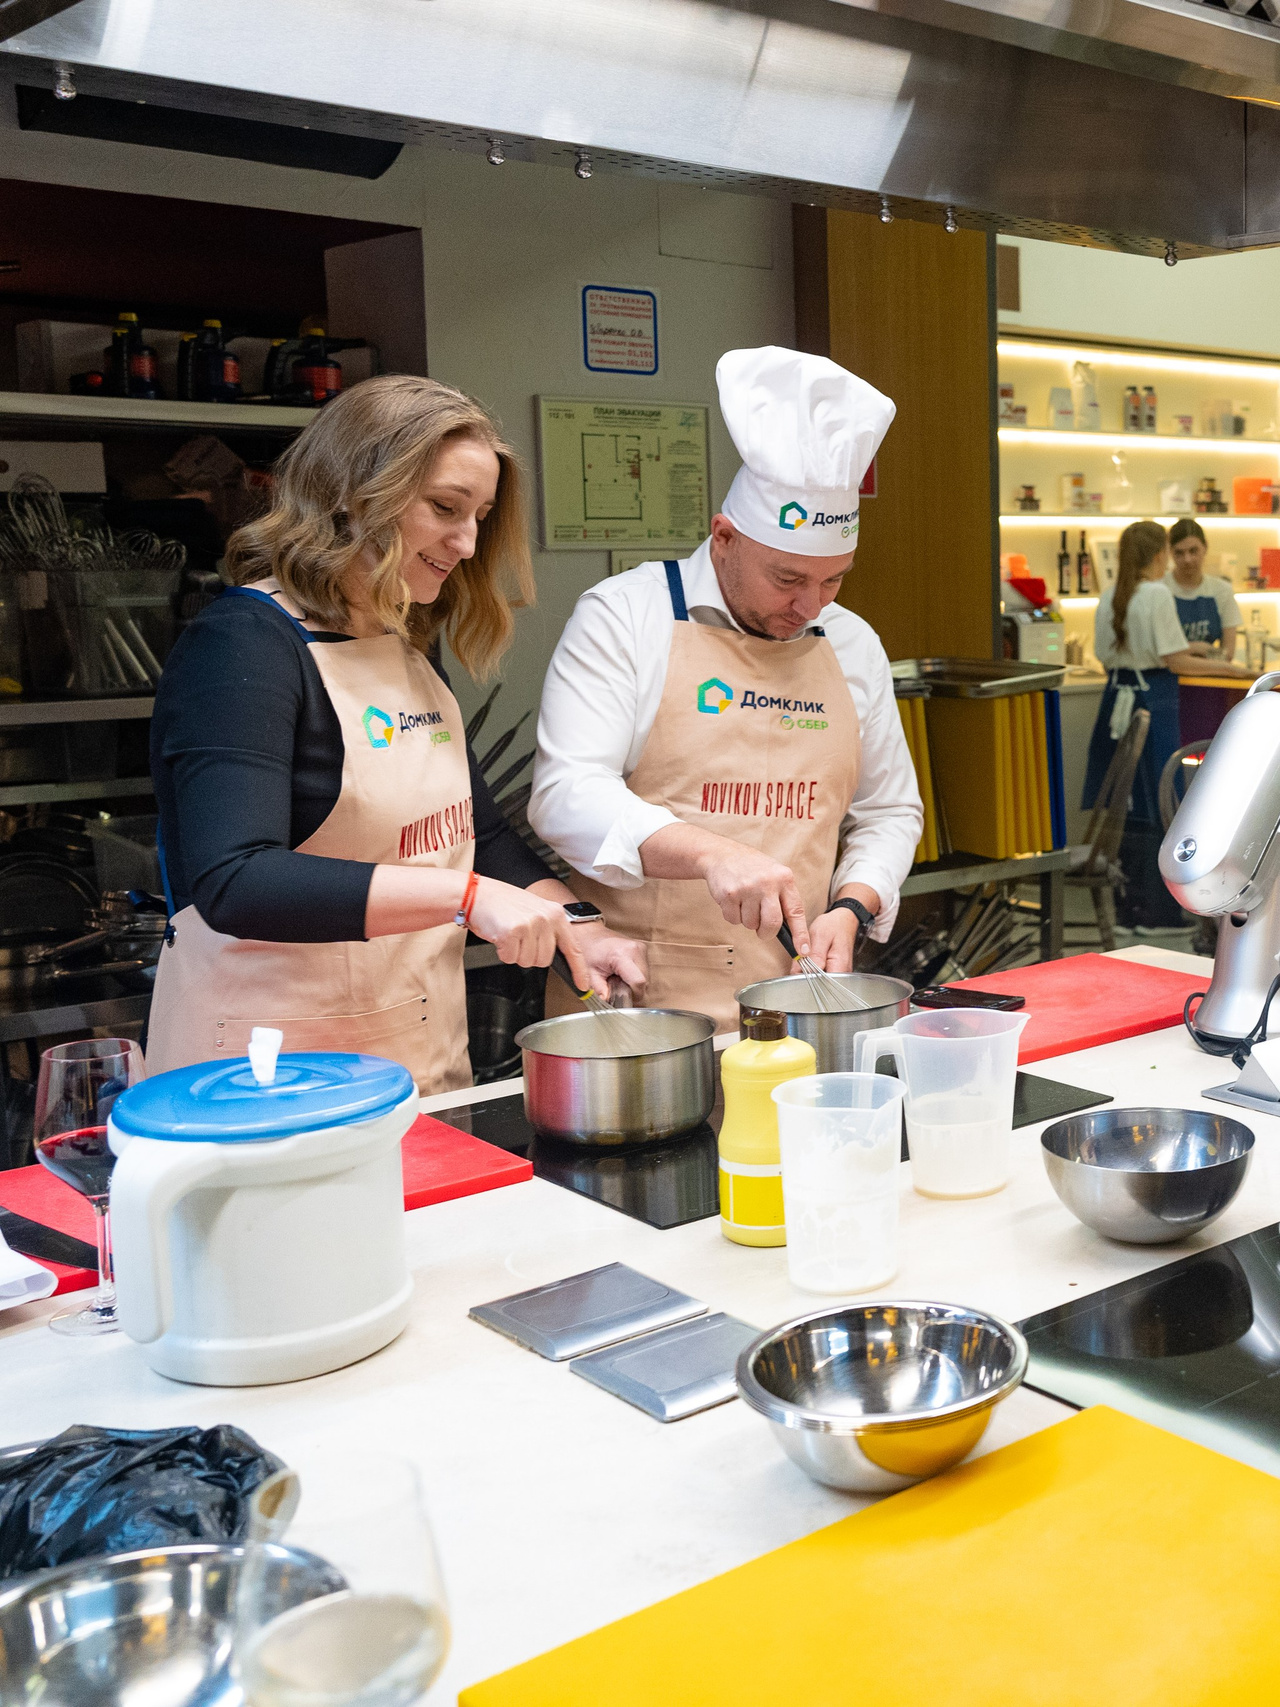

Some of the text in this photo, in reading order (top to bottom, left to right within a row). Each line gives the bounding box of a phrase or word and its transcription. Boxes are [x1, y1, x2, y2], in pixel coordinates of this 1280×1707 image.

[589, 294, 652, 305] ОТВЕТСТВЕННЫЙ
[593, 407, 662, 418] ПЛАН ЭВАКУАЦИИ
[740, 690, 826, 714] Домклик
[398, 711, 444, 734] Домклик
[796, 718, 829, 731] СБЕР
[700, 781, 818, 820] NOVIKOV SPACE
[399, 811, 447, 859] NOVIKOV
